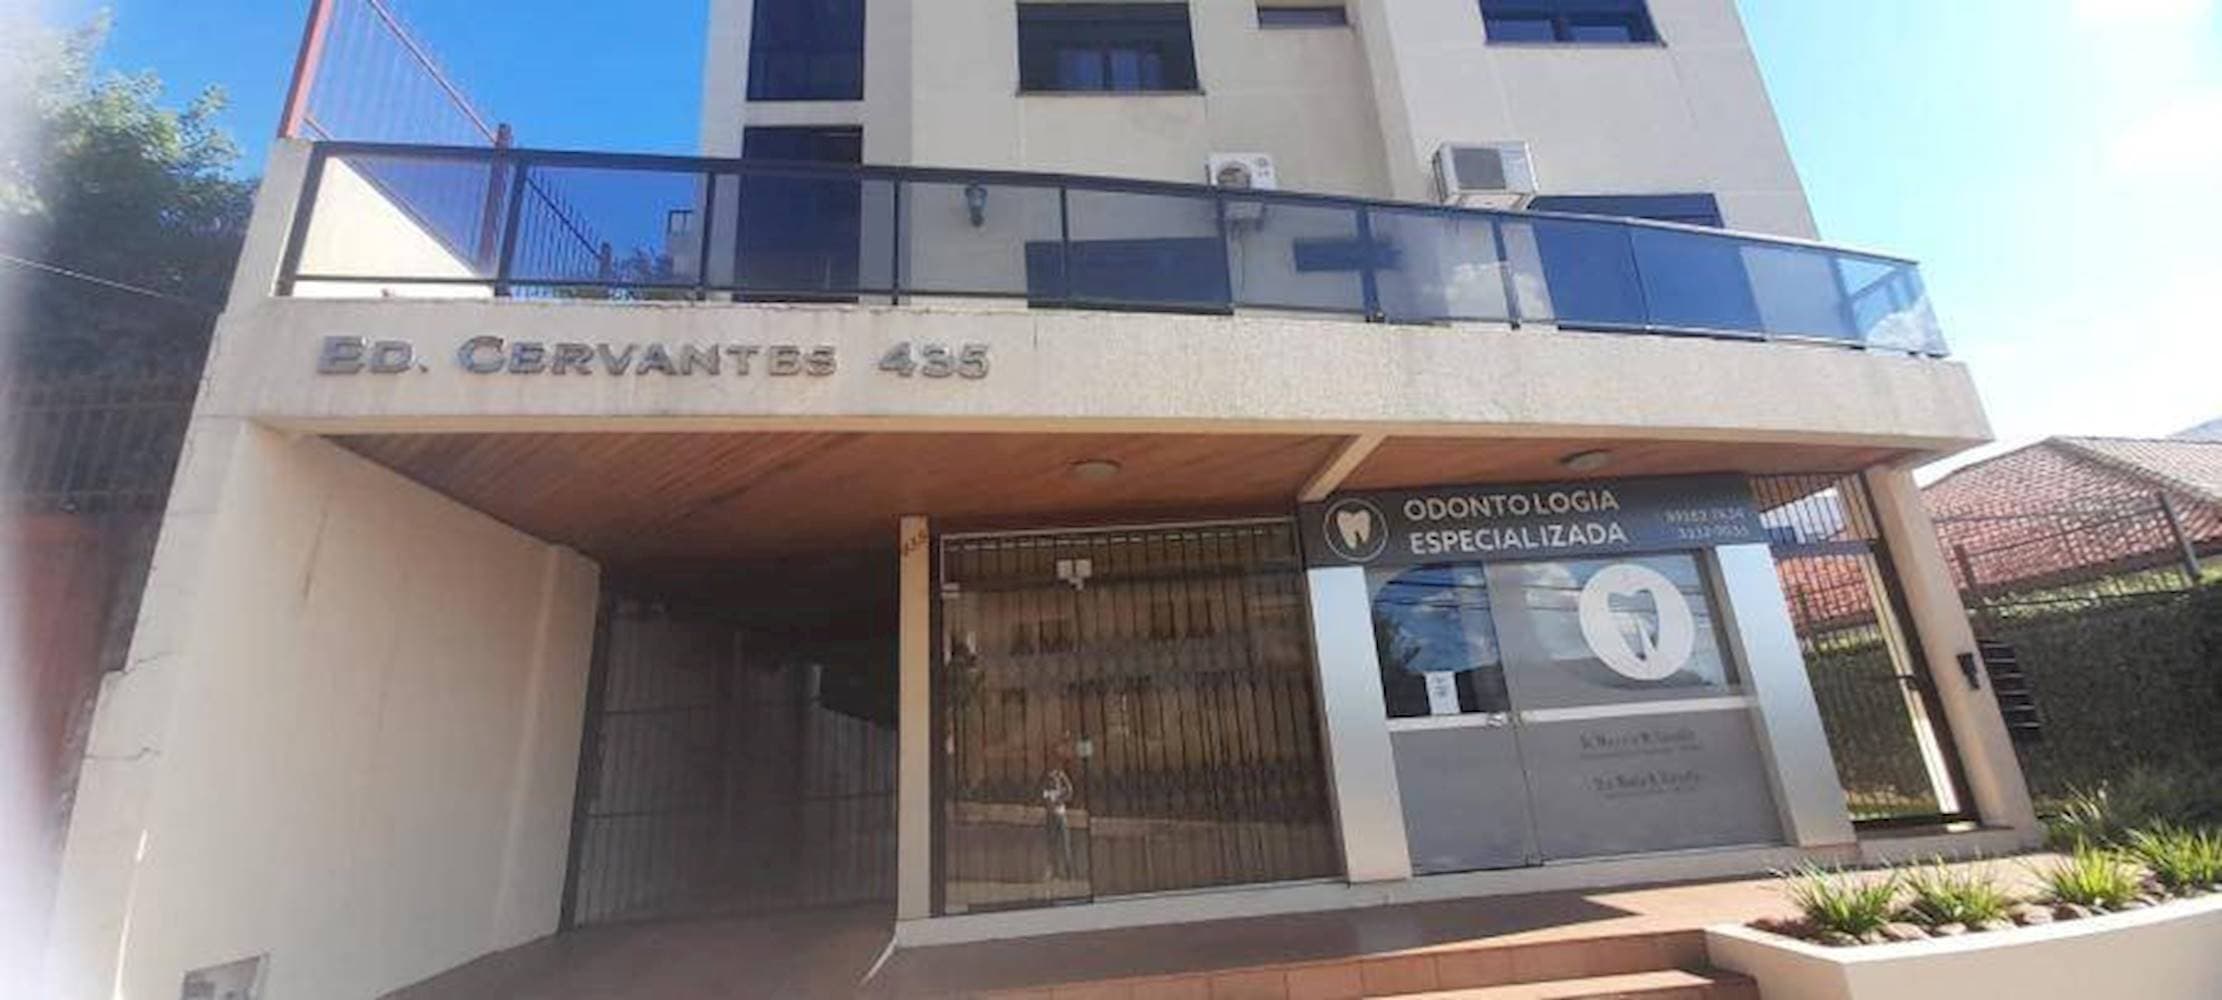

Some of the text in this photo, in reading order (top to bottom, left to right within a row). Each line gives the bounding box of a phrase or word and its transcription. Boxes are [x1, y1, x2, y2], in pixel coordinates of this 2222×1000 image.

[456, 334, 838, 377] CERVANTES
[876, 339, 991, 381] 435
[1404, 490, 1620, 521] ODONTOLOGIA
[1410, 522, 1629, 555] ESPECIALIZADA
